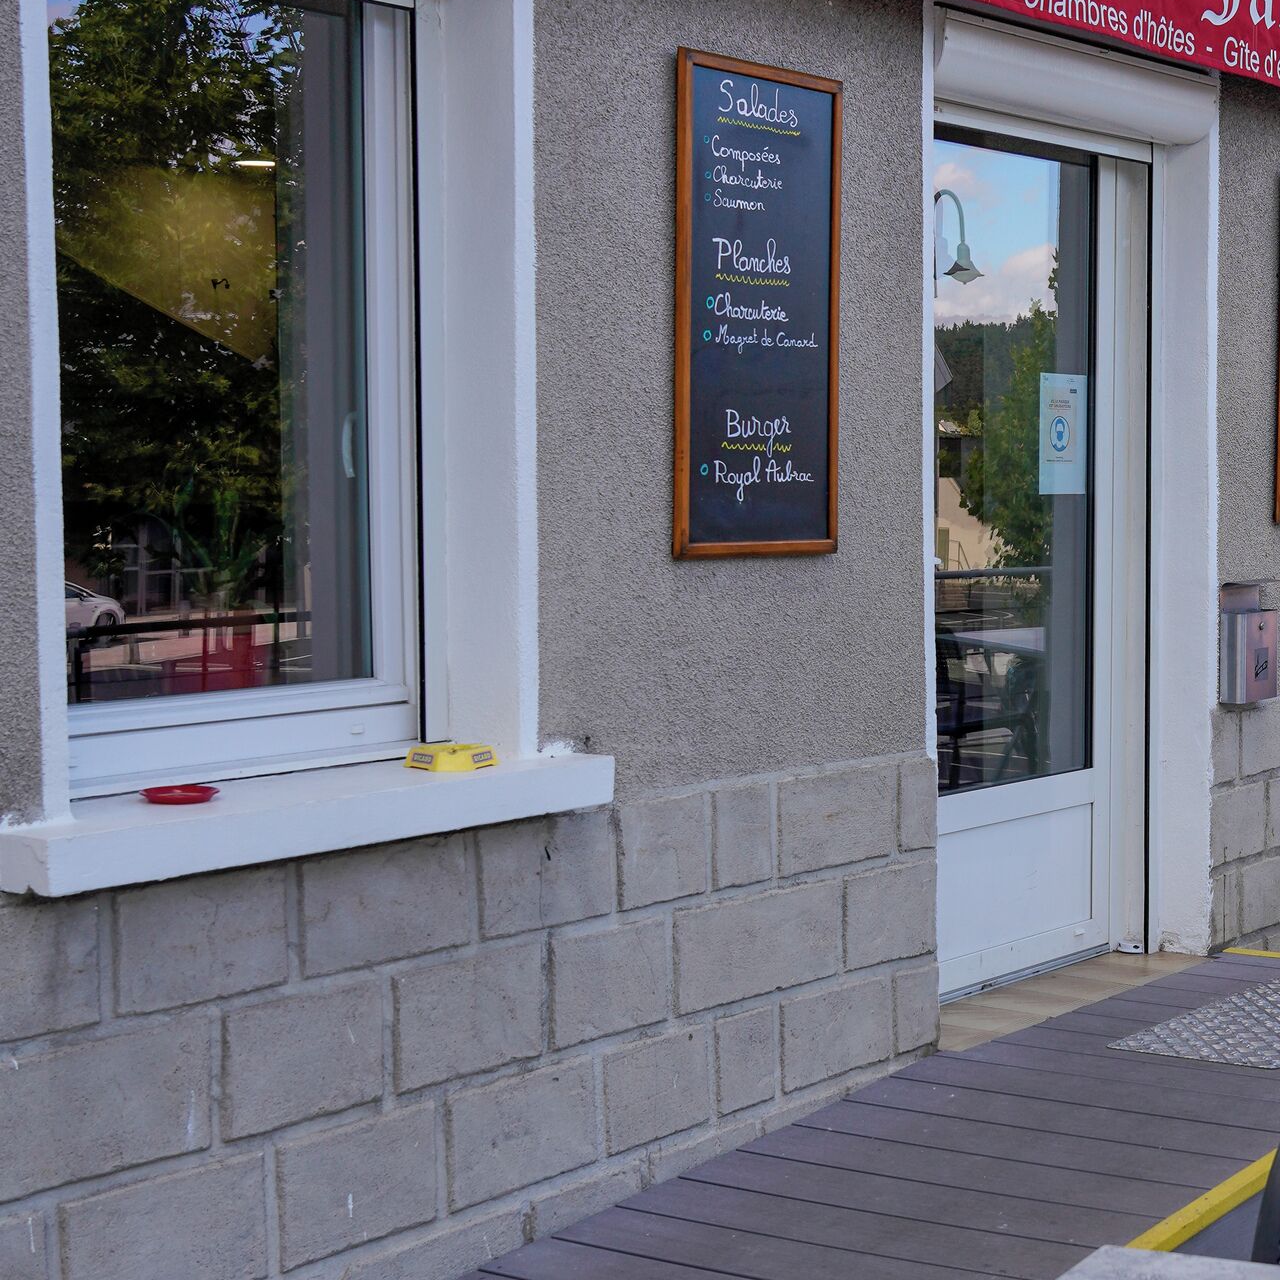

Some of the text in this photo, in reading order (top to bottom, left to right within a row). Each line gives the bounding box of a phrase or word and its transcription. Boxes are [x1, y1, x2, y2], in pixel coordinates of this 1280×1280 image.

[1132, 8, 1195, 56] d'hôtes
[1223, 35, 1260, 74] Gîte
[718, 78, 799, 128] Salades
[711, 134, 782, 172] Composées
[712, 165, 784, 190] Charcuterie
[712, 188, 766, 211] Saumon
[712, 236, 792, 275] Planches
[713, 293, 789, 322] Charcuterie
[714, 323, 819, 354] Magret de Canard
[725, 408, 792, 458] Burger
[713, 455, 815, 502] Royal Aubrac
